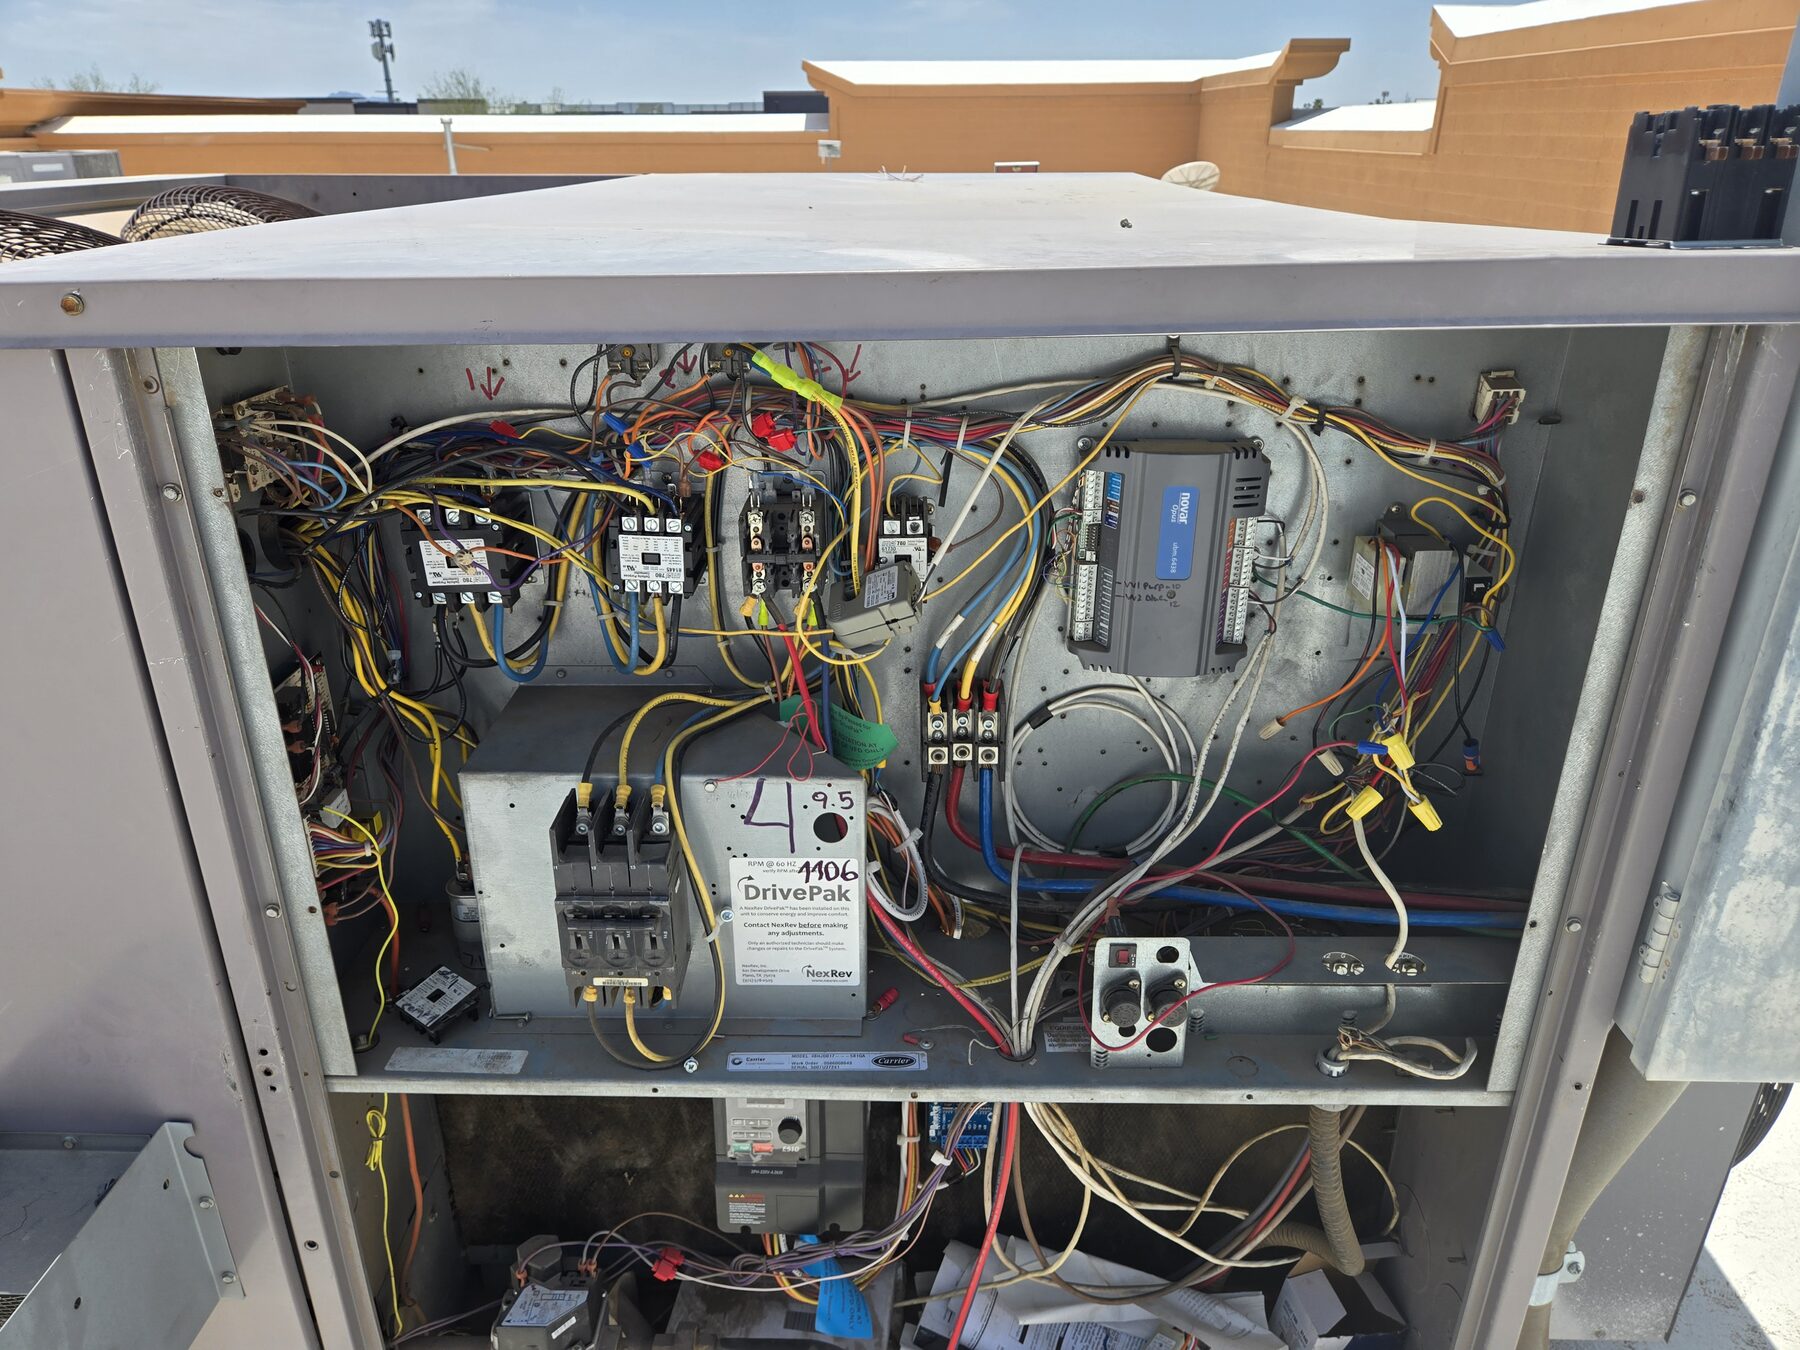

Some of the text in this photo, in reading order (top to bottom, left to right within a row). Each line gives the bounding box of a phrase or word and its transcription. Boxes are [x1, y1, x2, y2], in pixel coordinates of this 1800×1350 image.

[744, 778, 796, 854] 4
[744, 884, 851, 901] DrivePak
[806, 969, 852, 978] NexRev
